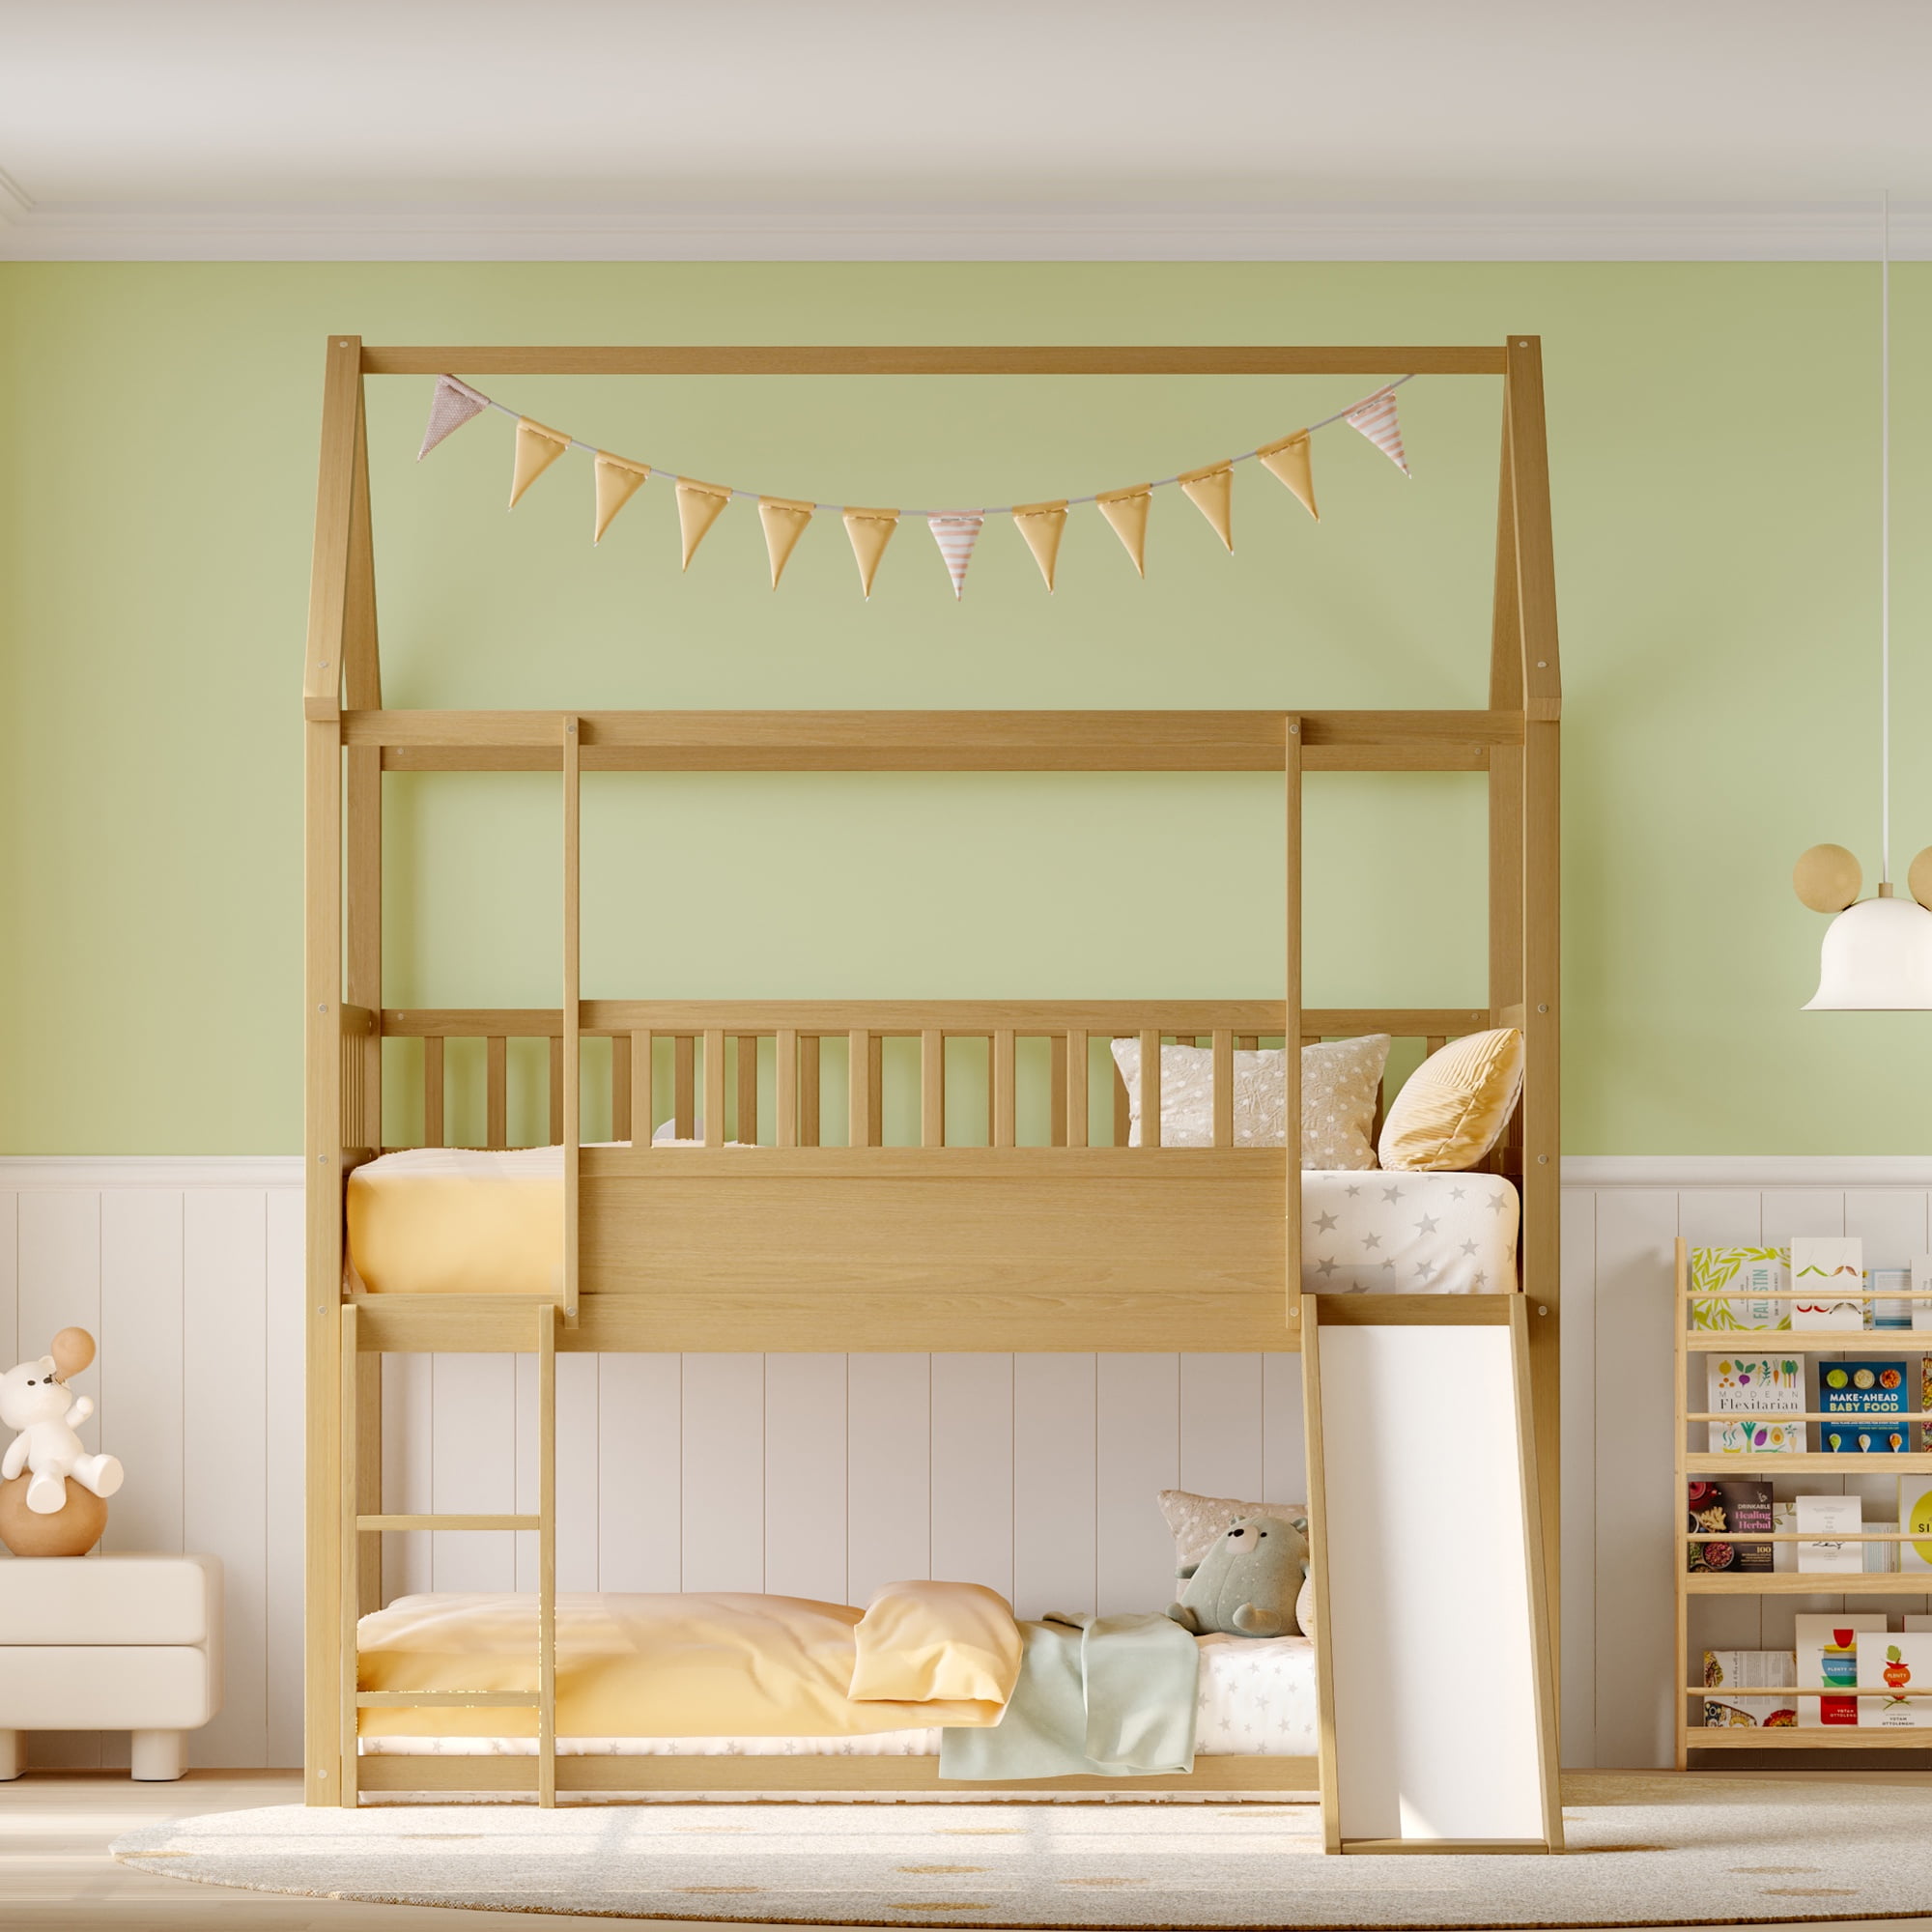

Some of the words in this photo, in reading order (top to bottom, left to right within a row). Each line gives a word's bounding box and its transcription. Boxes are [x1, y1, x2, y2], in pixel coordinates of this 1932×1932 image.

[1752, 1269, 1769, 1320] FALSTIN
[1830, 1393, 1899, 1402] MAKE-AHEAD
[1720, 1398, 1799, 1410] Flexitarian
[1830, 1403, 1861, 1412] BABY
[1863, 1403, 1899, 1412] FOOD
[1735, 1511, 1772, 1520] Healing
[1739, 1520, 1772, 1530] Herbal
